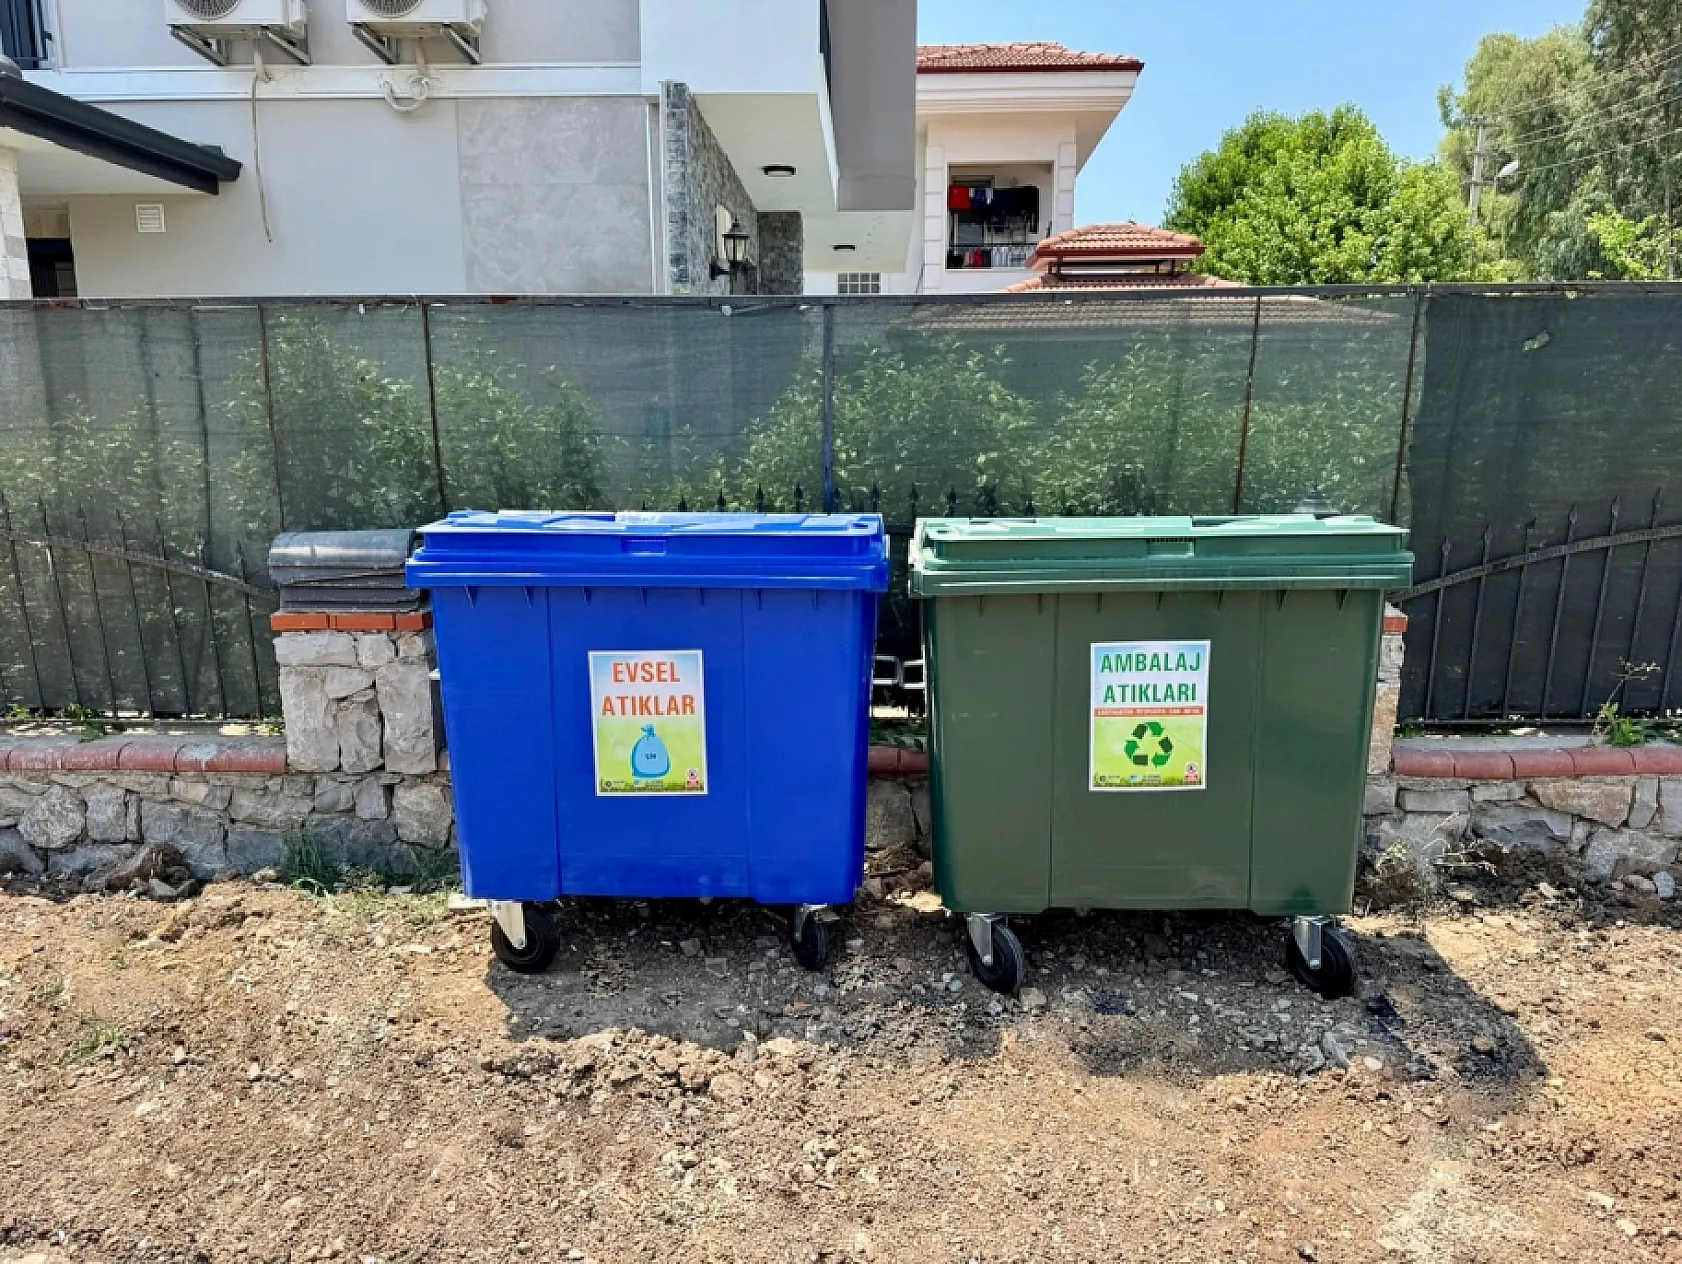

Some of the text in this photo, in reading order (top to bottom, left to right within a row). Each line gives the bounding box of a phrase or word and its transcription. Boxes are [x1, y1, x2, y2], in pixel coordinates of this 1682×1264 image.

[612, 661, 680, 683] EVSEL
[1100, 651, 1201, 673] AMBALAJ
[1103, 683, 1197, 703] ATIKLARI
[602, 694, 695, 716] ATIKLAR
